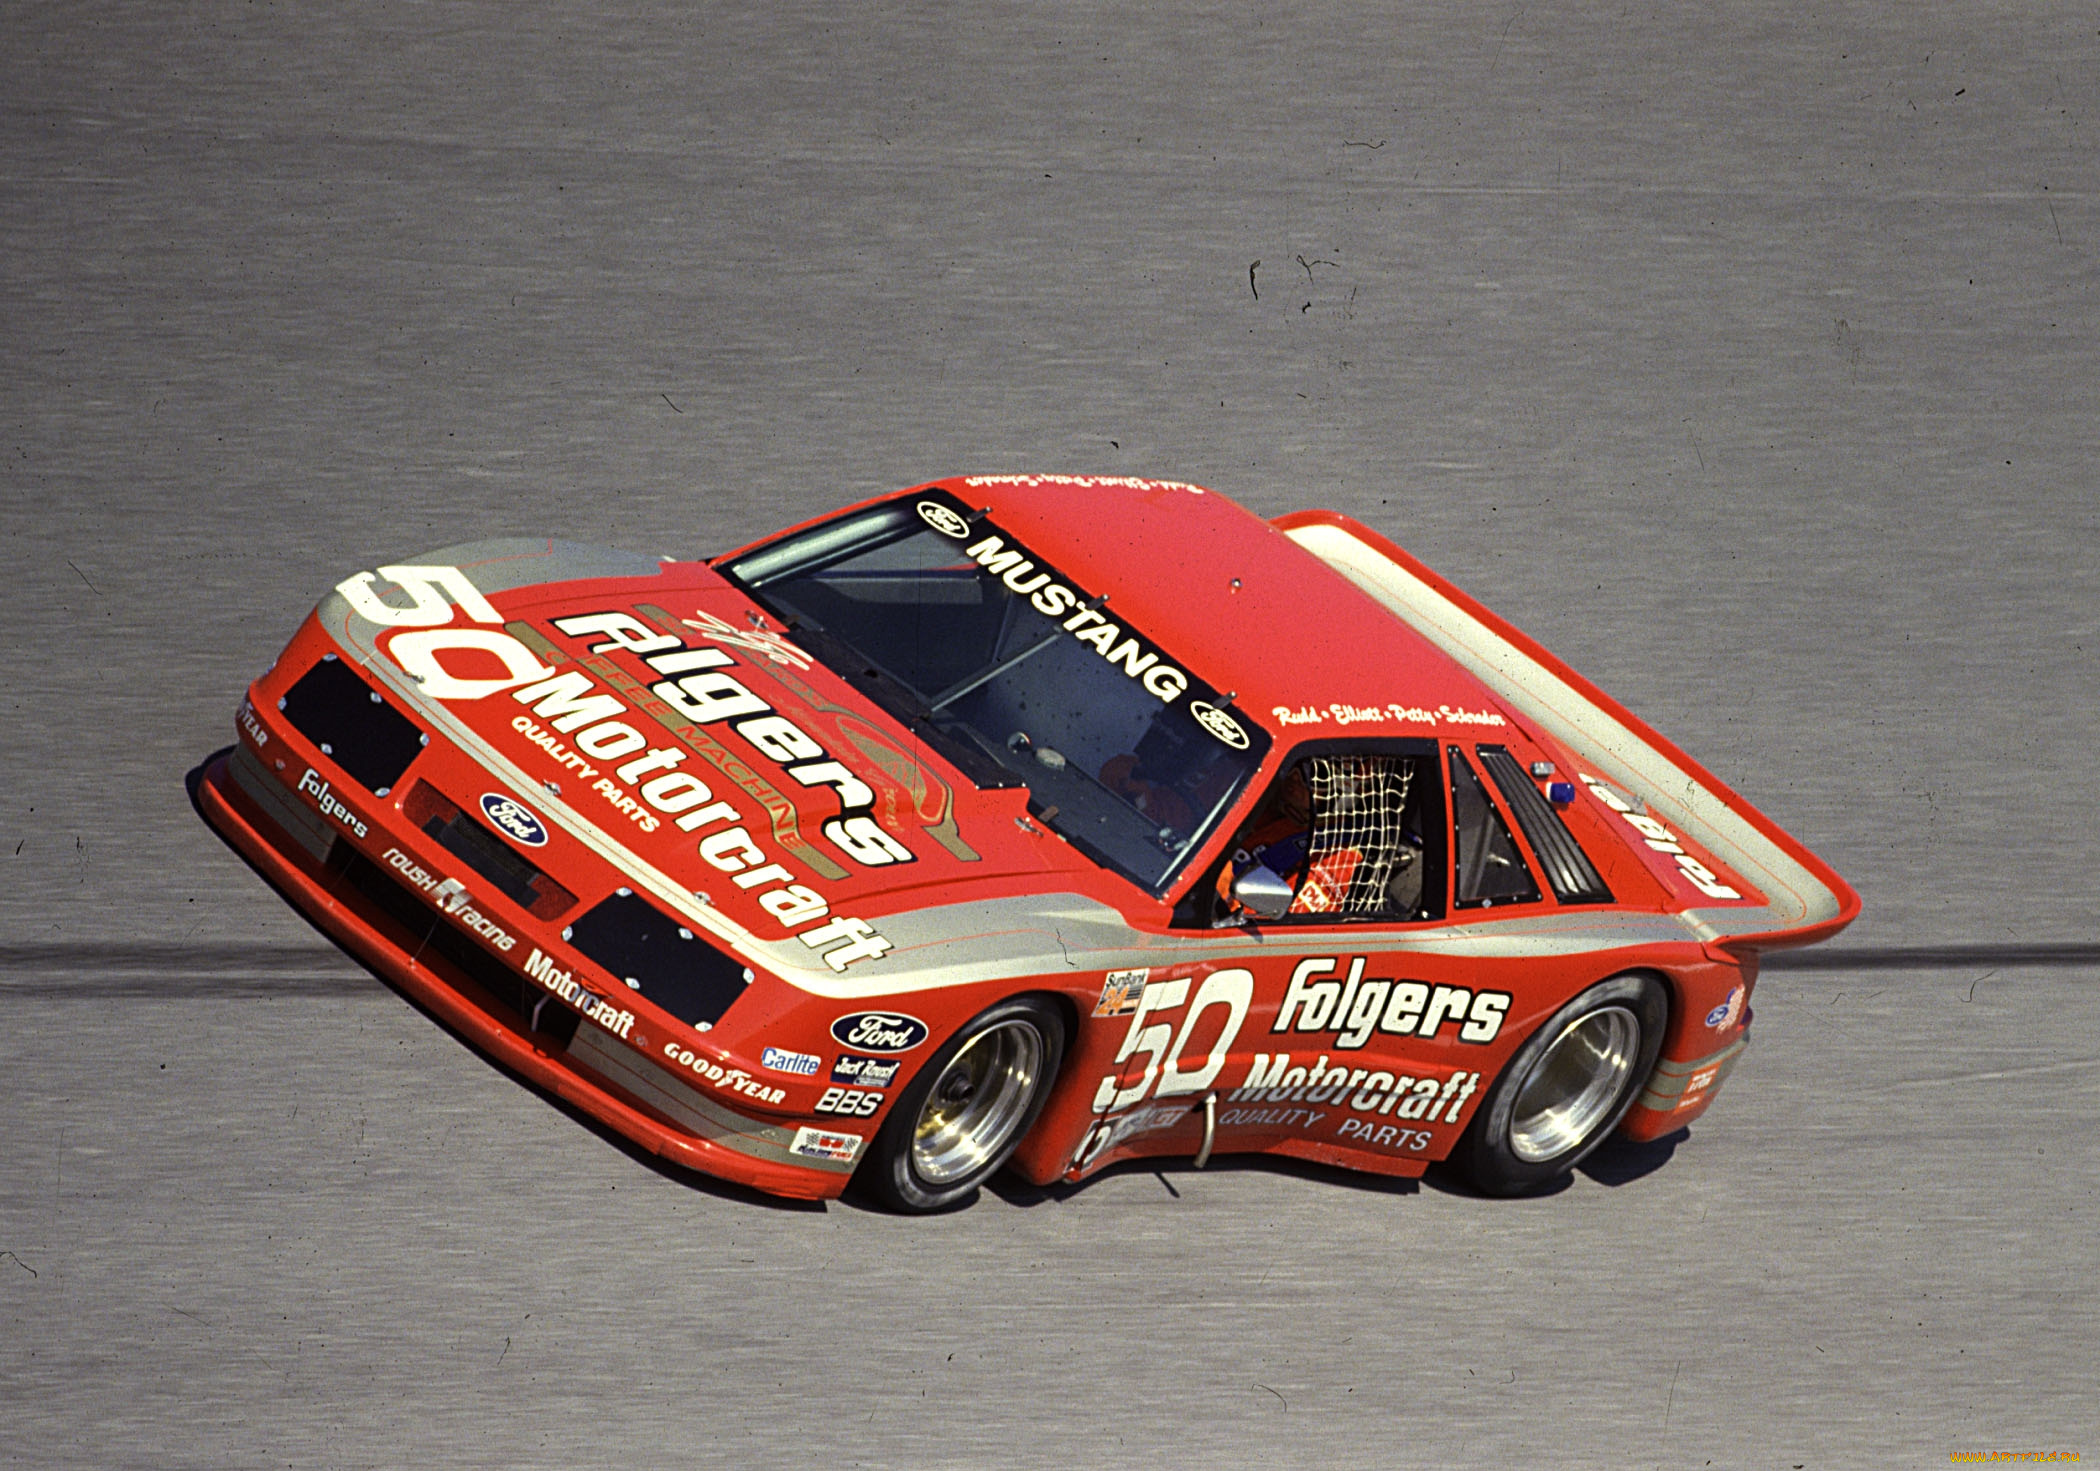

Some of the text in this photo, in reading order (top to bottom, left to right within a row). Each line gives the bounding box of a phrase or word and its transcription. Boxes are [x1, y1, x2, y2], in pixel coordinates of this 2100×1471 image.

[925, 507, 961, 533] Ford
[335, 565, 557, 700] 50
[966, 535, 1188, 703] MUSTANG
[1201, 707, 1240, 742] Ford
[1272, 706, 1322, 726] Rudd
[1329, 704, 1384, 725] Elliott
[1388, 704, 1436, 726] Petty
[511, 716, 660, 833] QUALITY PARTS
[545, 651, 673, 719] CFFEE
[676, 725, 806, 851] MACHINE
[297, 768, 368, 838] Folgers
[489, 800, 537, 839] Ford
[511, 670, 894, 973] Motorcraft
[524, 949, 635, 1039] Motorcraft
[1273, 957, 1513, 1049] Folgers
[762, 1048, 820, 1076] Carlite
[848, 1014, 910, 1048] Ford
[1092, 968, 1254, 1114] 50
[663, 1041, 786, 1105] GOODYEAR
[814, 1088, 884, 1117] BBS
[1228, 1054, 1480, 1125] Motorcraft
[1219, 1108, 1432, 1152] QUALITY PARTS
